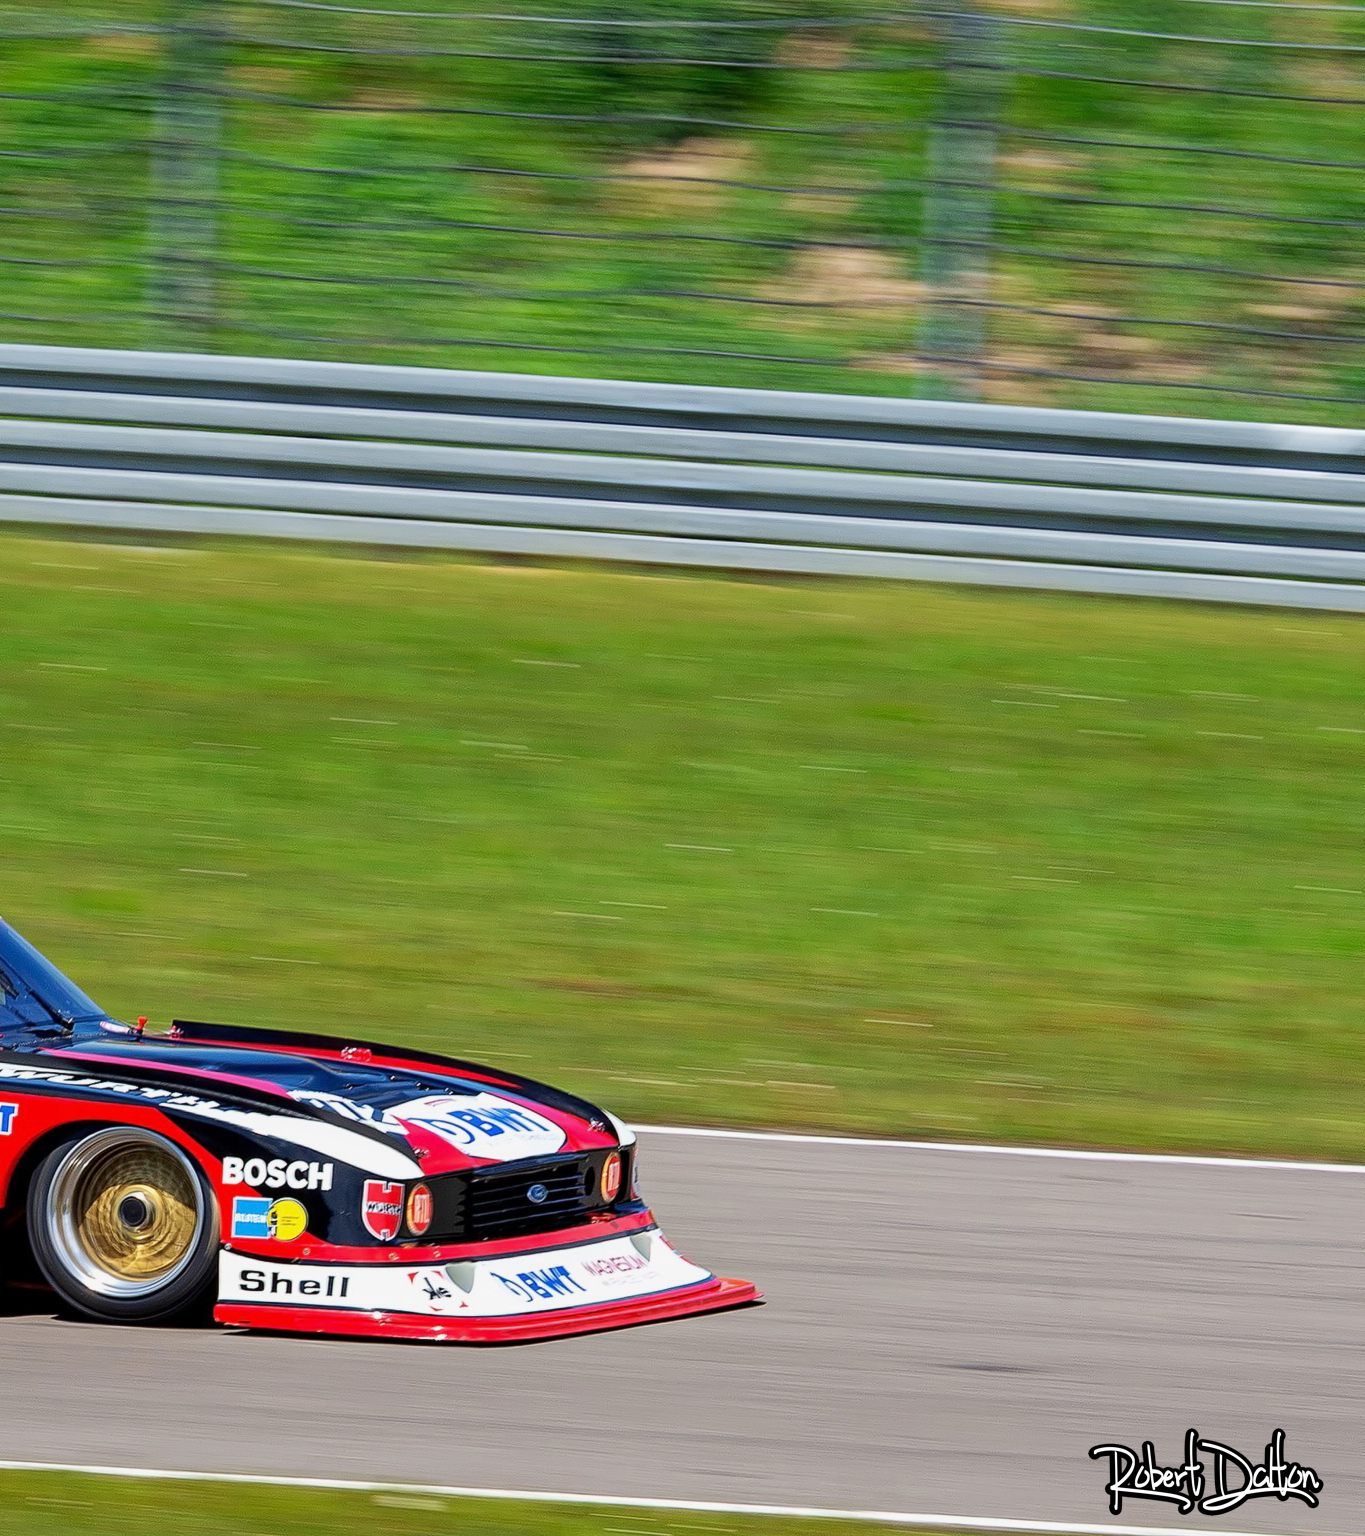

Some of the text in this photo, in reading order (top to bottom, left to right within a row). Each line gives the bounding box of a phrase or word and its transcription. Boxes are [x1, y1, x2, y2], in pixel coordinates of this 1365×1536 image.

[446, 1107, 550, 1136] BWT
[222, 1156, 334, 1191] BOSCH
[239, 1269, 350, 1297] Shell
[516, 1265, 587, 1299] BWT
